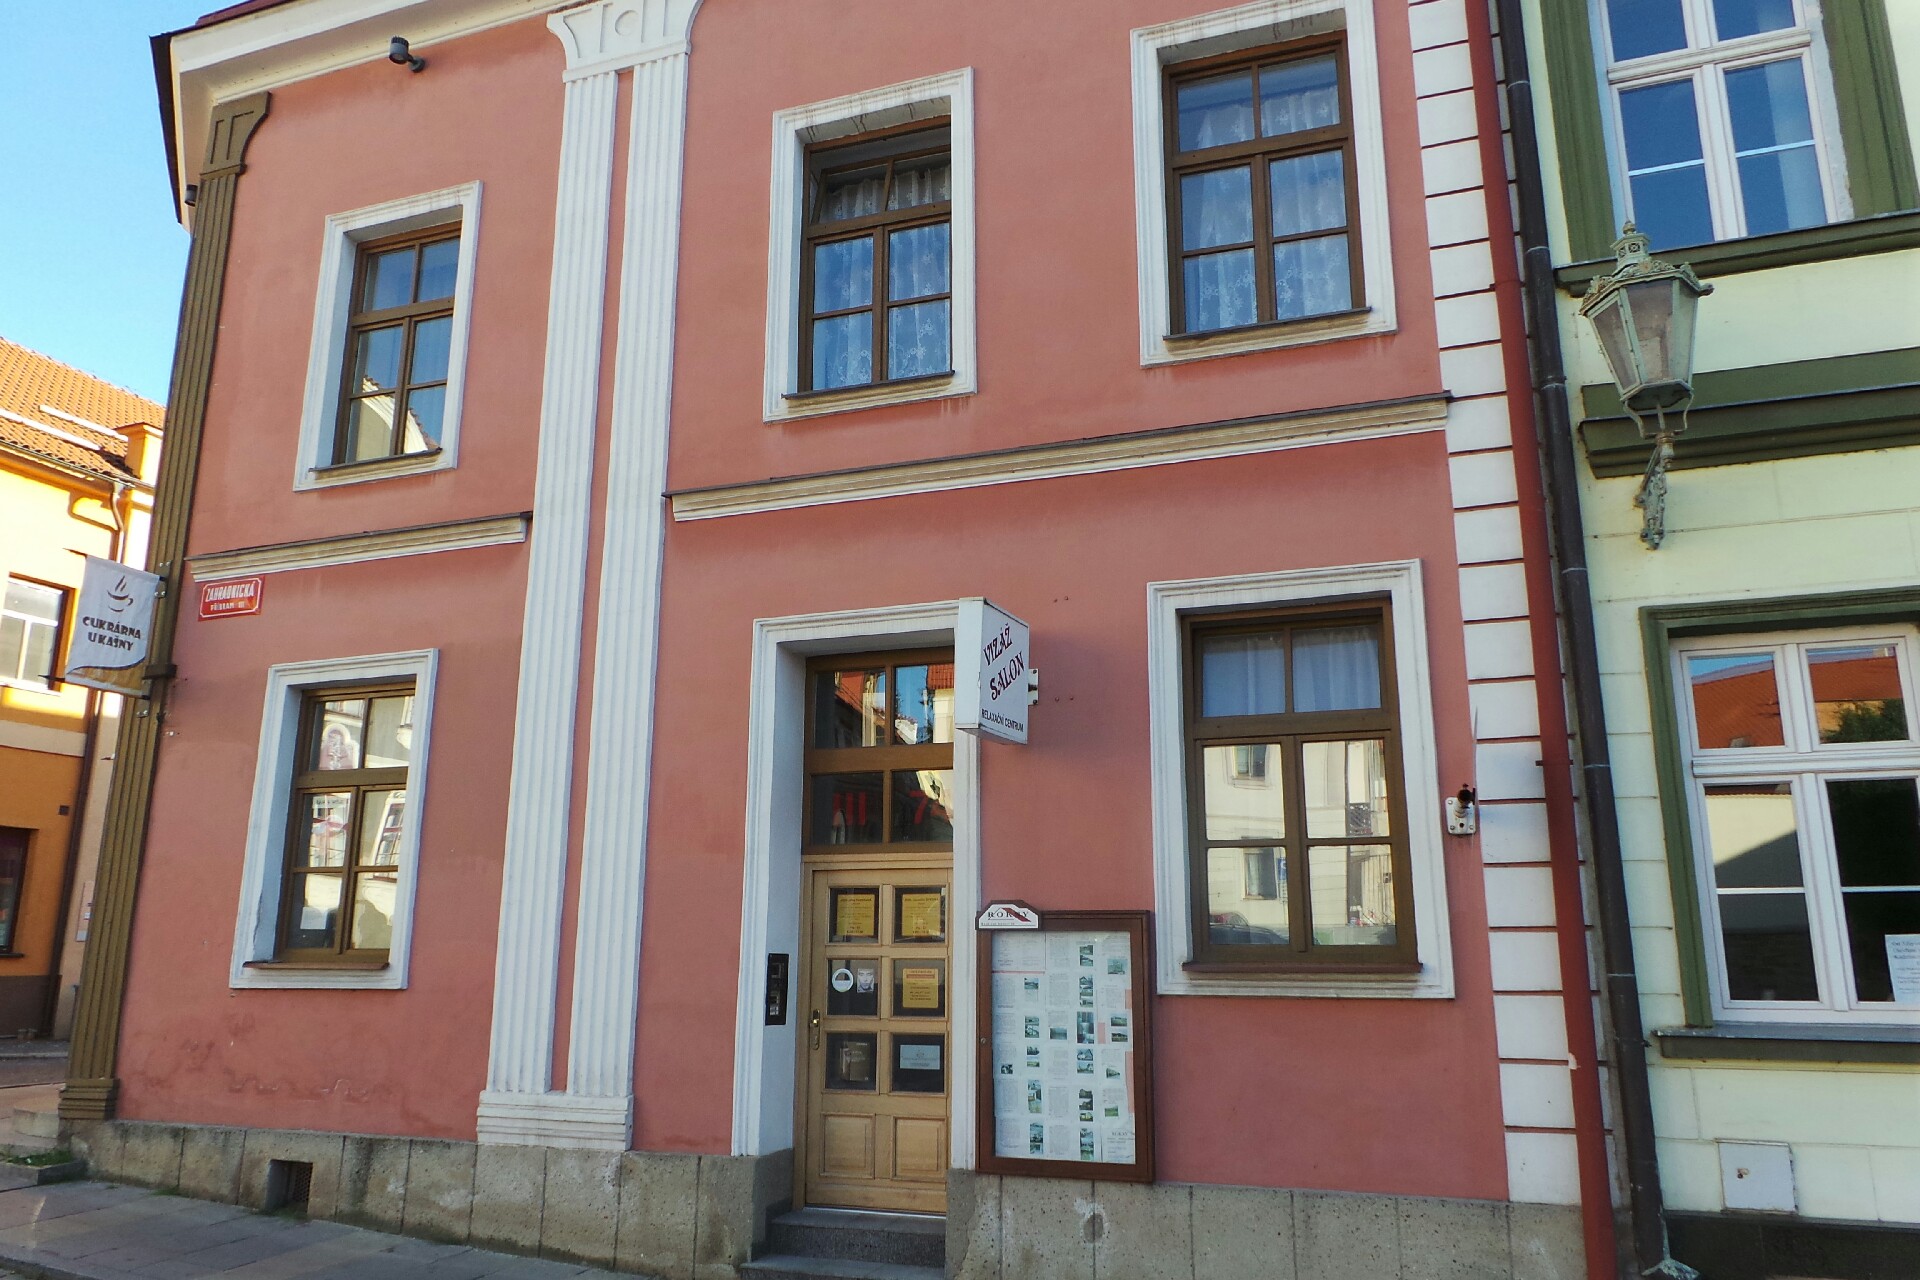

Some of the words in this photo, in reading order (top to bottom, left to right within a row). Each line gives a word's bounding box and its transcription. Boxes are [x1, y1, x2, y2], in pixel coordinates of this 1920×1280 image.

[82, 616, 141, 640] CUKRÁRNA
[88, 632, 97, 643] U
[98, 634, 134, 651] KAŠNY
[983, 622, 1013, 666] VIZÁŽ
[989, 651, 1025, 701] SALON
[981, 708, 1005, 726] RELAXAČNÍ
[1004, 717, 1024, 733] CENTRUM
